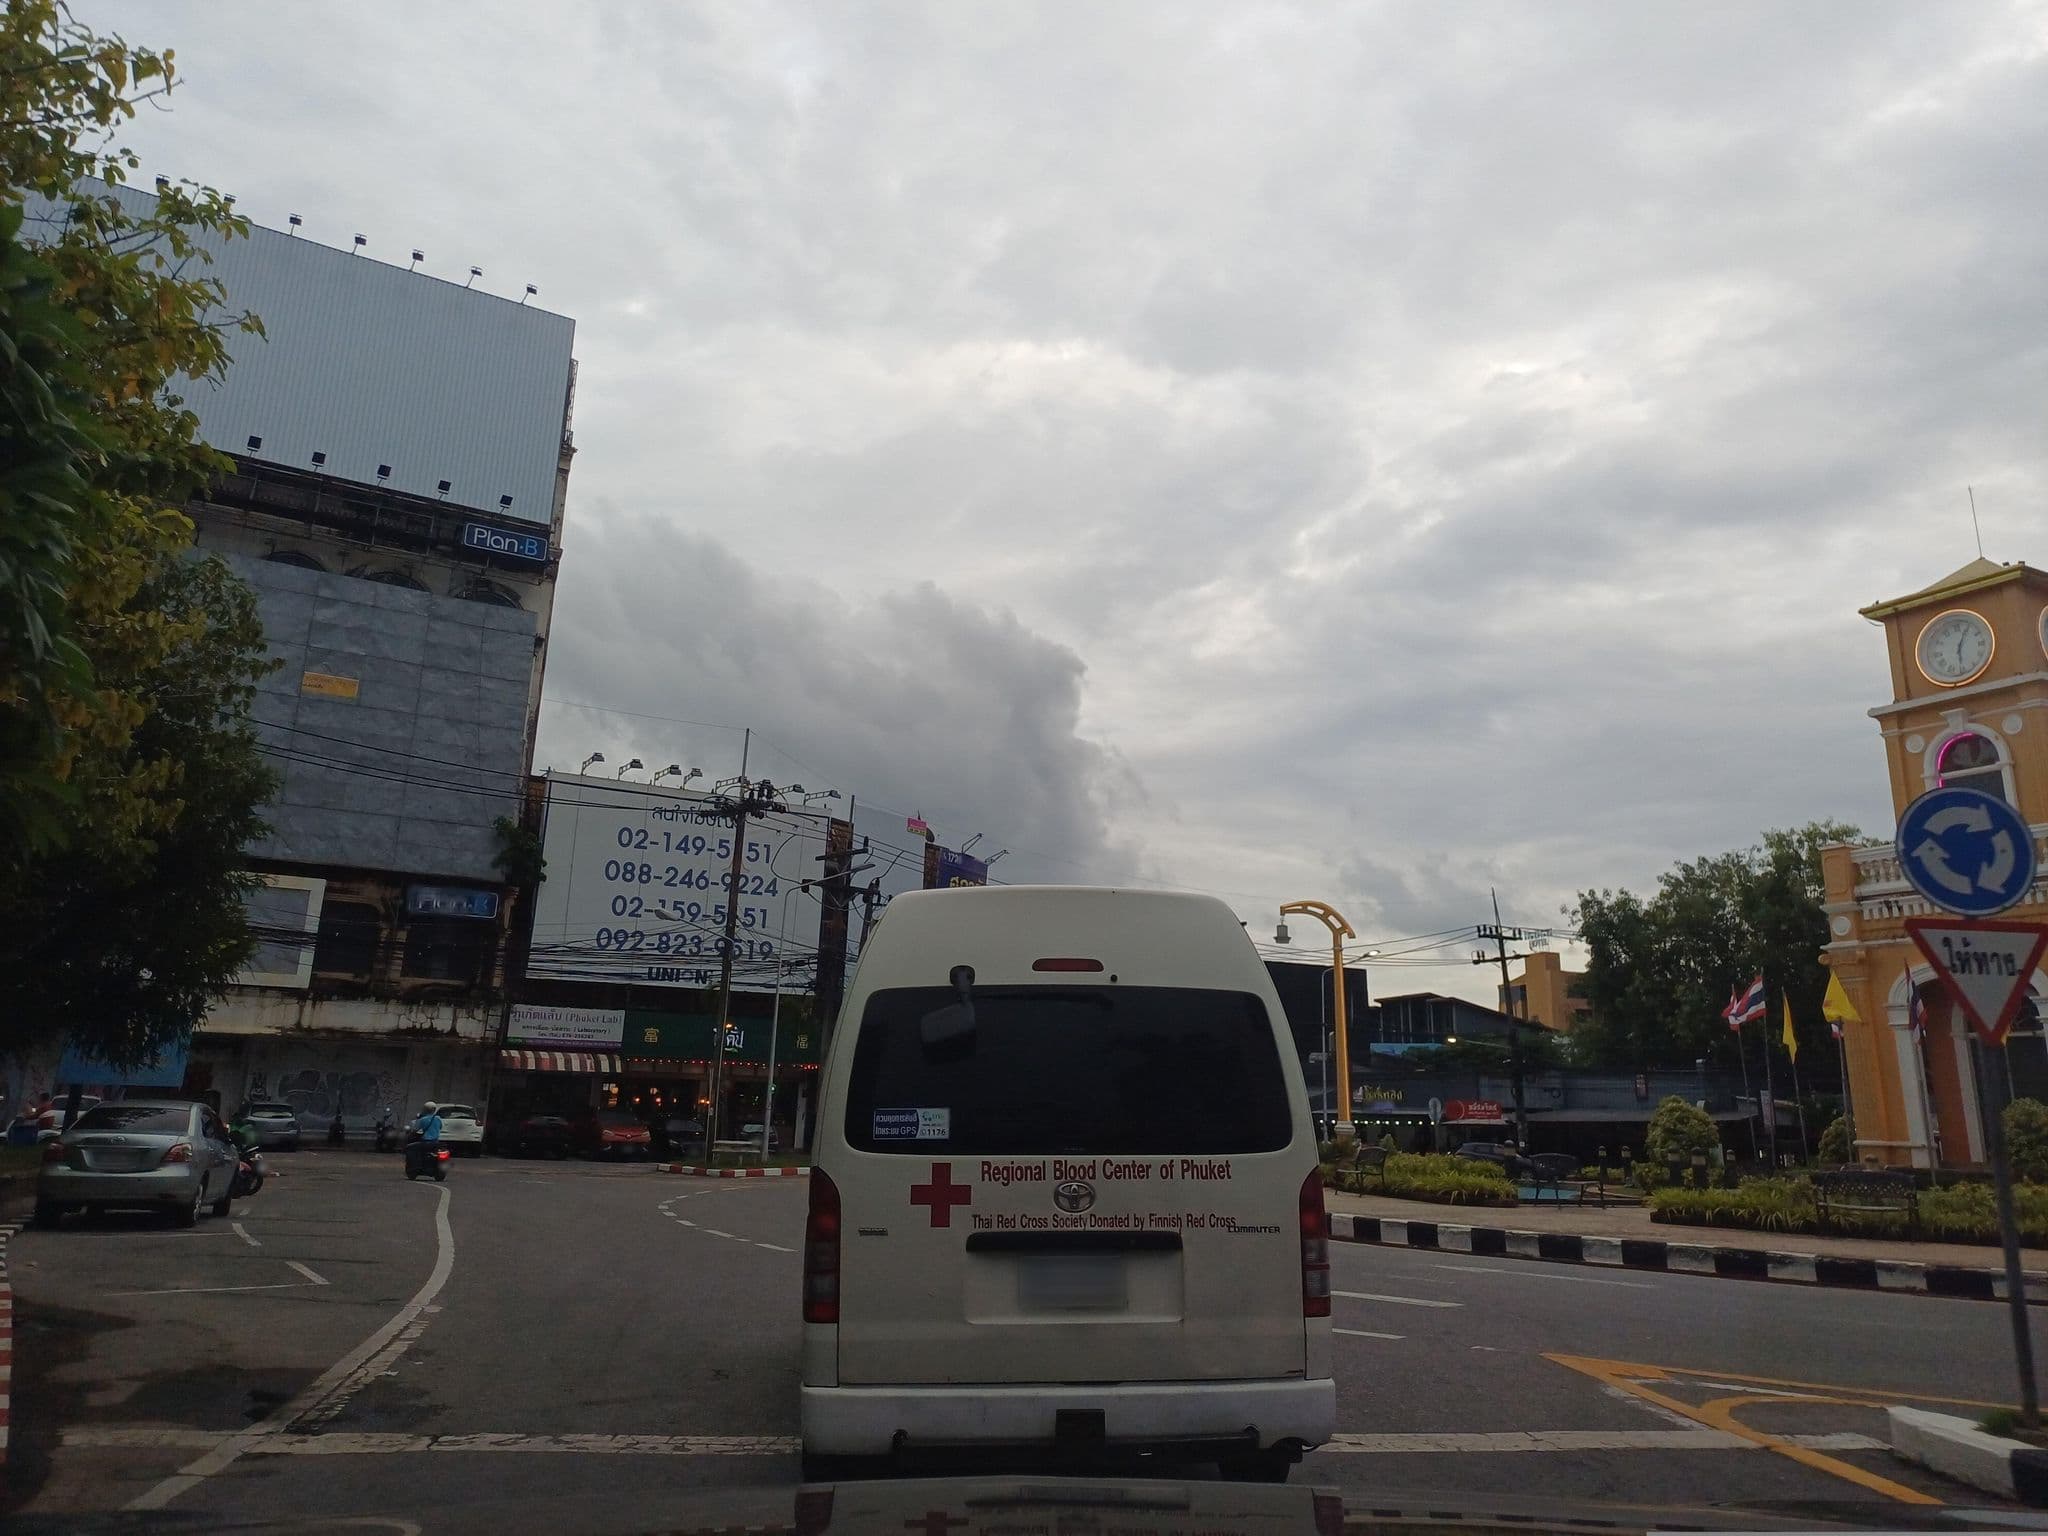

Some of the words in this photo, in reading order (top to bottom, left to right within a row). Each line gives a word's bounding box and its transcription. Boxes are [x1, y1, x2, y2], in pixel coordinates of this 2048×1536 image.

[652, 804, 738, 829] สนใจโฆษณ
[617, 826, 771, 864] 02-149-551
[604, 859, 778, 897] 088-246-9224
[611, 894, 768, 929] 02-159-551
[900, 1126, 917, 1135] GPS
[980, 1160, 1046, 1186] Regional
[1053, 1160, 1097, 1180] Blood
[1102, 1159, 1152, 1180] Center
[1160, 1159, 1174, 1180] of
[1182, 1159, 1232, 1180] Phuket
[972, 1214, 993, 1229] Thai
[997, 1214, 1016, 1229] Red
[1020, 1214, 1048, 1229] Cross
[1052, 1214, 1088, 1231] Society
[1089, 1214, 1130, 1229] Donated
[1133, 1214, 1144, 1231] by
[1149, 1214, 1182, 1229] Finnish
[1186, 1214, 1205, 1229] Red
[1209, 1214, 1236, 1229] Cross
